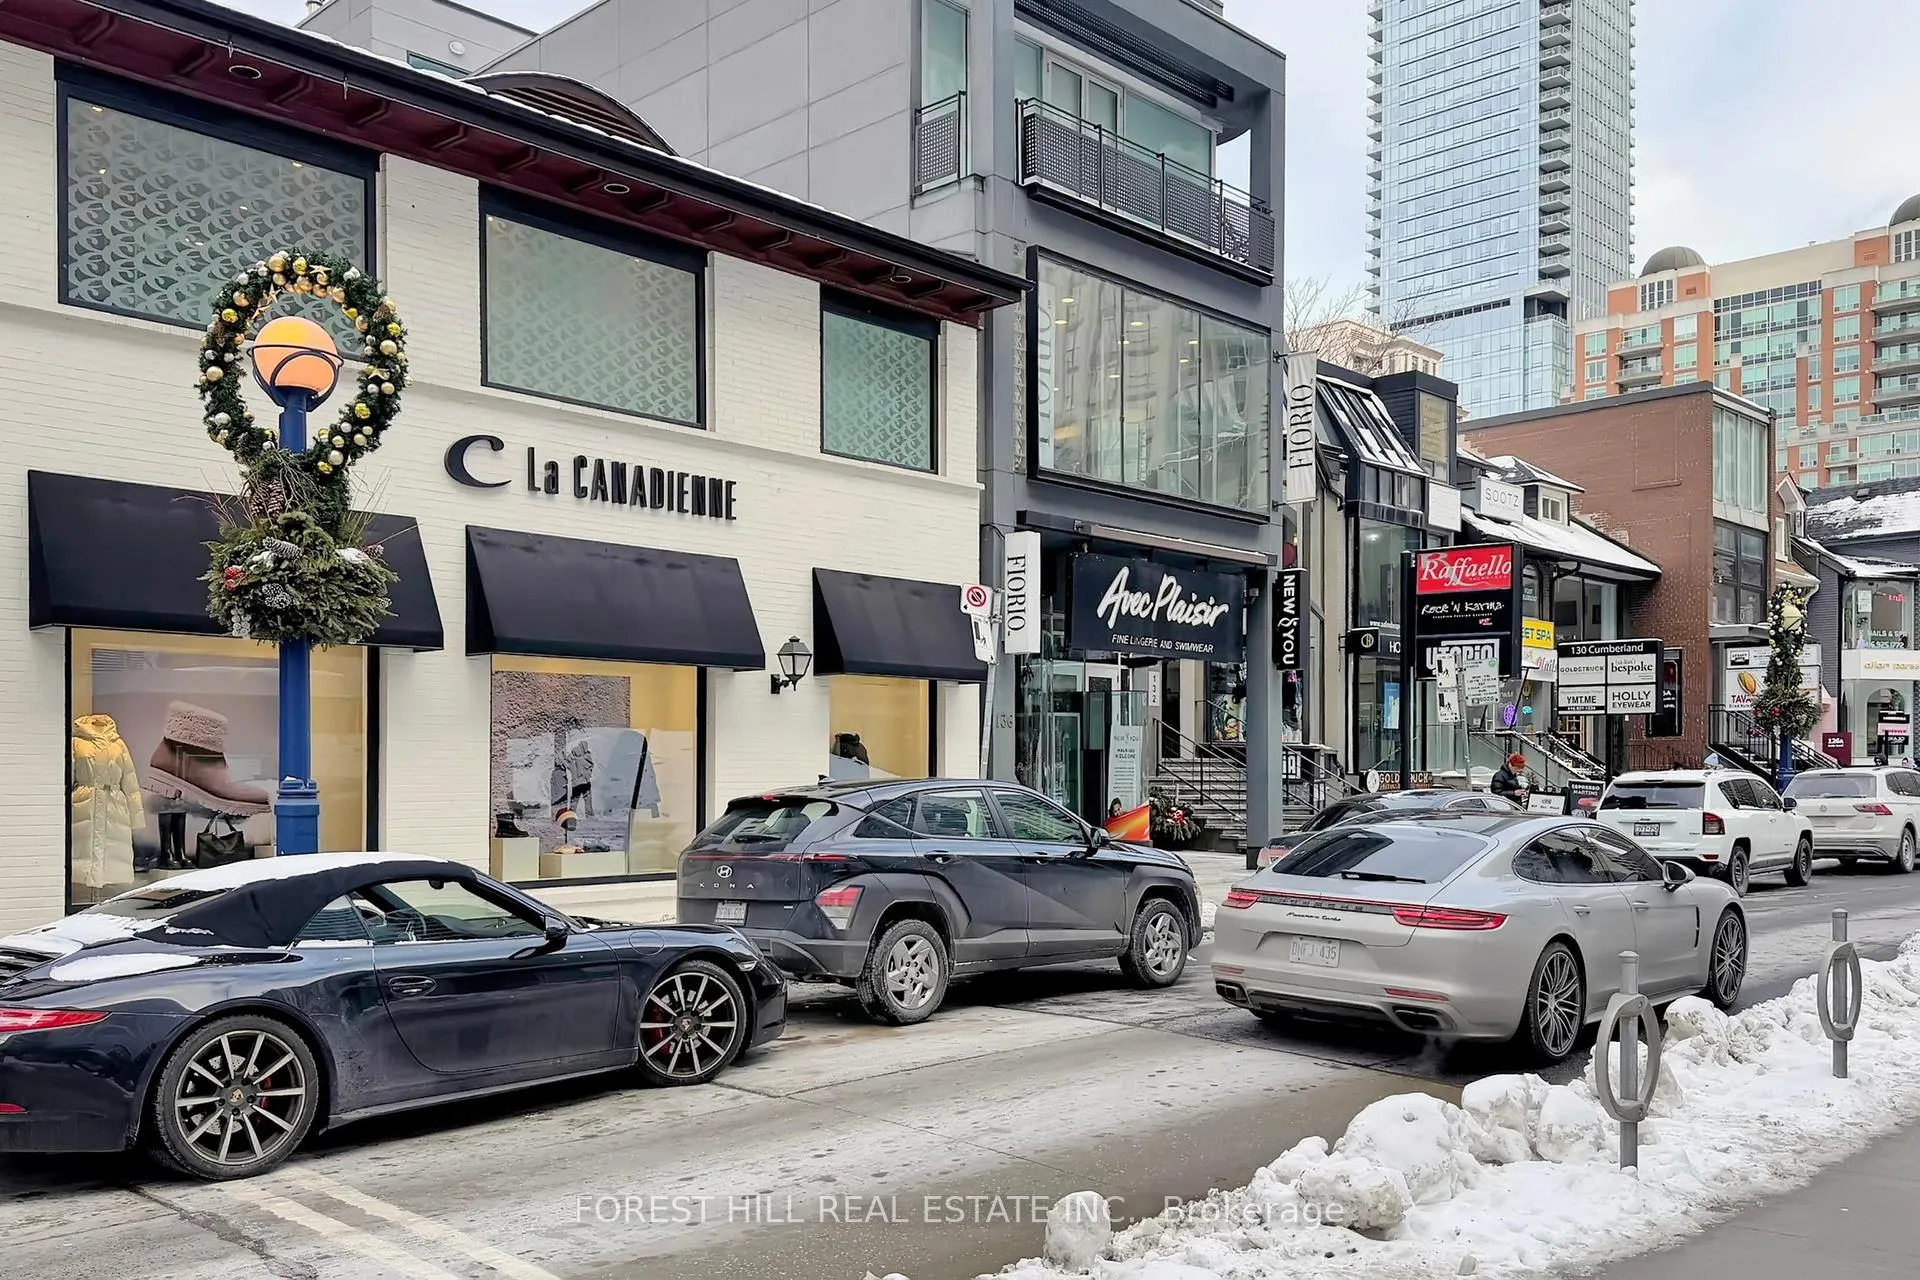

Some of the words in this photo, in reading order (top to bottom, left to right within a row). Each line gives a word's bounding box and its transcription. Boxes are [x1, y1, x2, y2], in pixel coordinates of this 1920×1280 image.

[1289, 384, 1313, 469] FIORIO
[527, 447, 559, 494] La
[573, 455, 737, 520] CANADIENNE
[1485, 487, 1520, 507] SOOTZ
[1420, 554, 1512, 587] Raffaello
[1007, 553, 1027, 632] FIORIO
[1096, 566, 1154, 630] Avec
[1151, 573, 1229, 627] Plaisir
[1283, 574, 1296, 620] NEW
[1111, 633, 1129, 645] FINE
[1129, 635, 1158, 648] LINGERIE
[1159, 639, 1173, 650] AND
[1174, 641, 1214, 653] SWIMWEAR
[1536, 629, 1552, 642] SPA
[1282, 628, 1296, 665] YOU
[1571, 646, 1587, 655] 130
[1588, 642, 1644, 654] Cumberland
[1559, 665, 1604, 673] GOLDSTRUCK
[1611, 661, 1653, 675] bespoke
[1612, 690, 1651, 701] HOLLY
[1612, 700, 1651, 709] EYEWEAR
